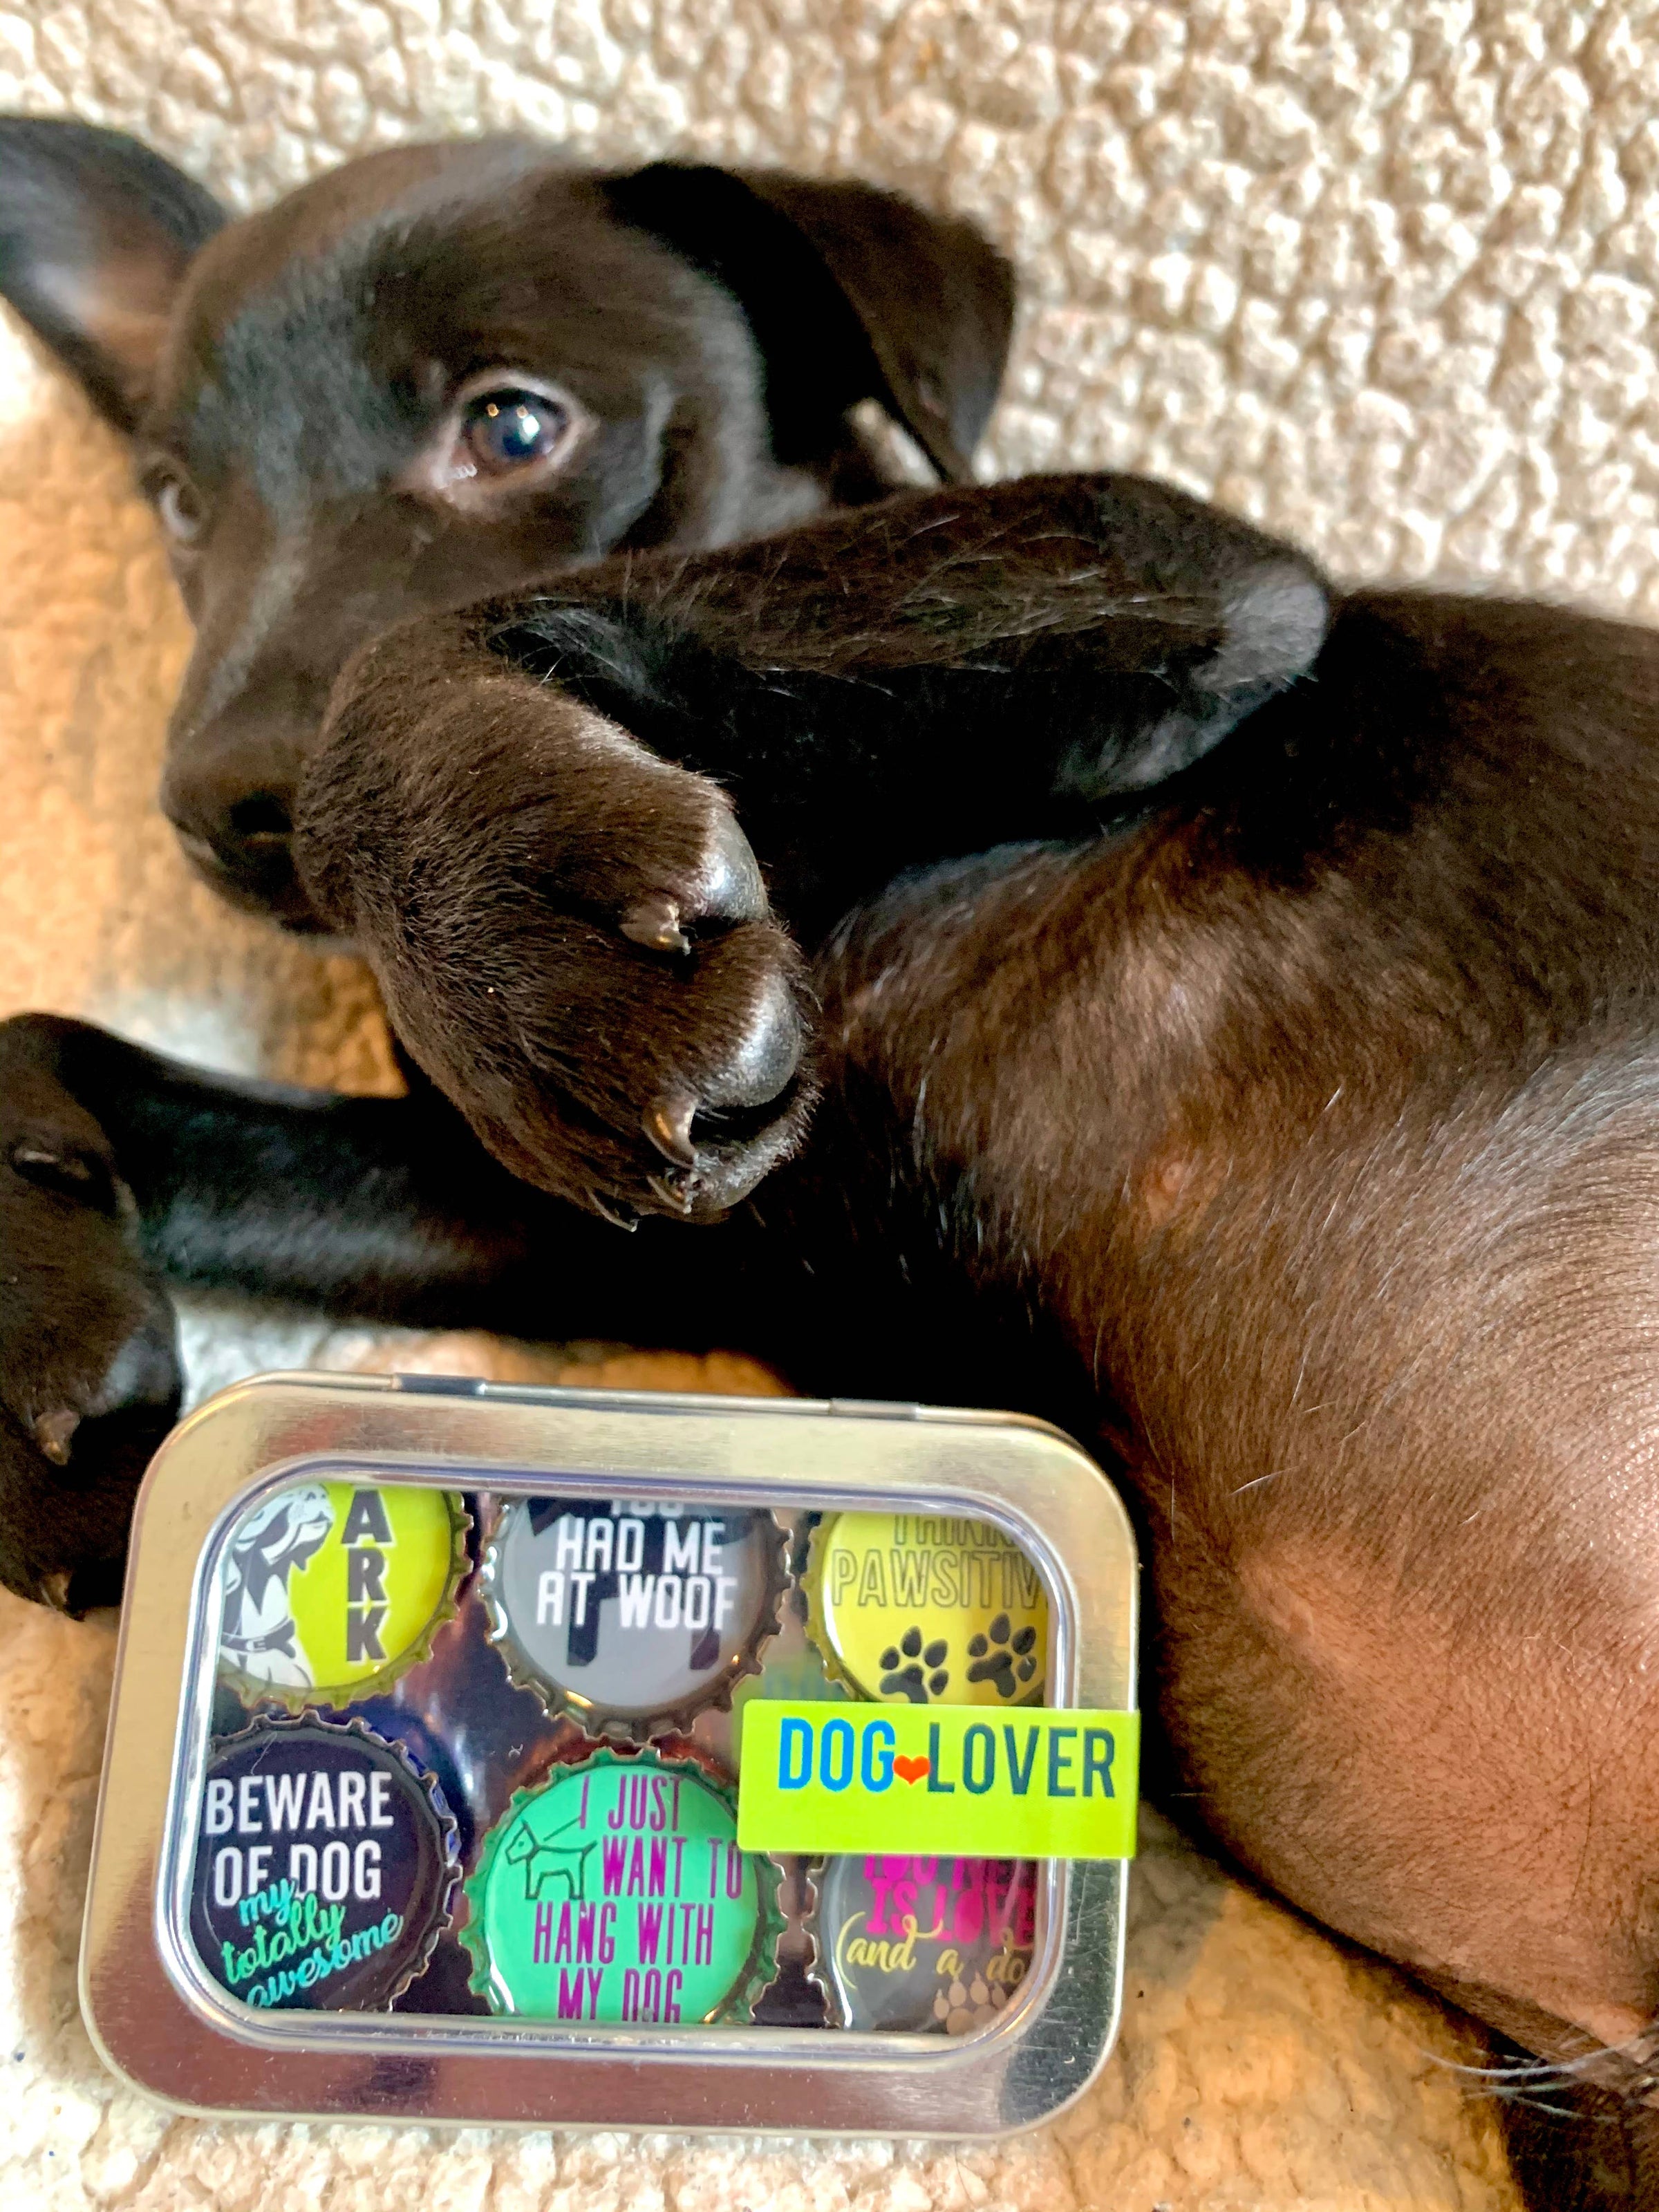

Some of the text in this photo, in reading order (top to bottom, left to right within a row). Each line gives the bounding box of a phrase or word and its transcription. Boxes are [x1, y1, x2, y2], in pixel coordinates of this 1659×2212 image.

[556, 1517, 726, 1575] HAD ME
[536, 1571, 738, 1631] AT WOOF
[778, 1717, 1116, 1797] DOG LOVER
[206, 1771, 394, 1835] BEWARE
[579, 1774, 682, 1831] I JUST
[214, 1839, 382, 1908] OF DOG
[603, 1835, 743, 1900] WANT TO
[238, 1877, 296, 1927] my
[533, 1900, 715, 1966] HANG WITH
[865, 1877, 918, 1938] IS
[221, 1893, 346, 1985] totally
[246, 1911, 404, 2008] awesome
[936, 1949, 964, 1978] a
[558, 1967, 683, 2023] MY DOG
